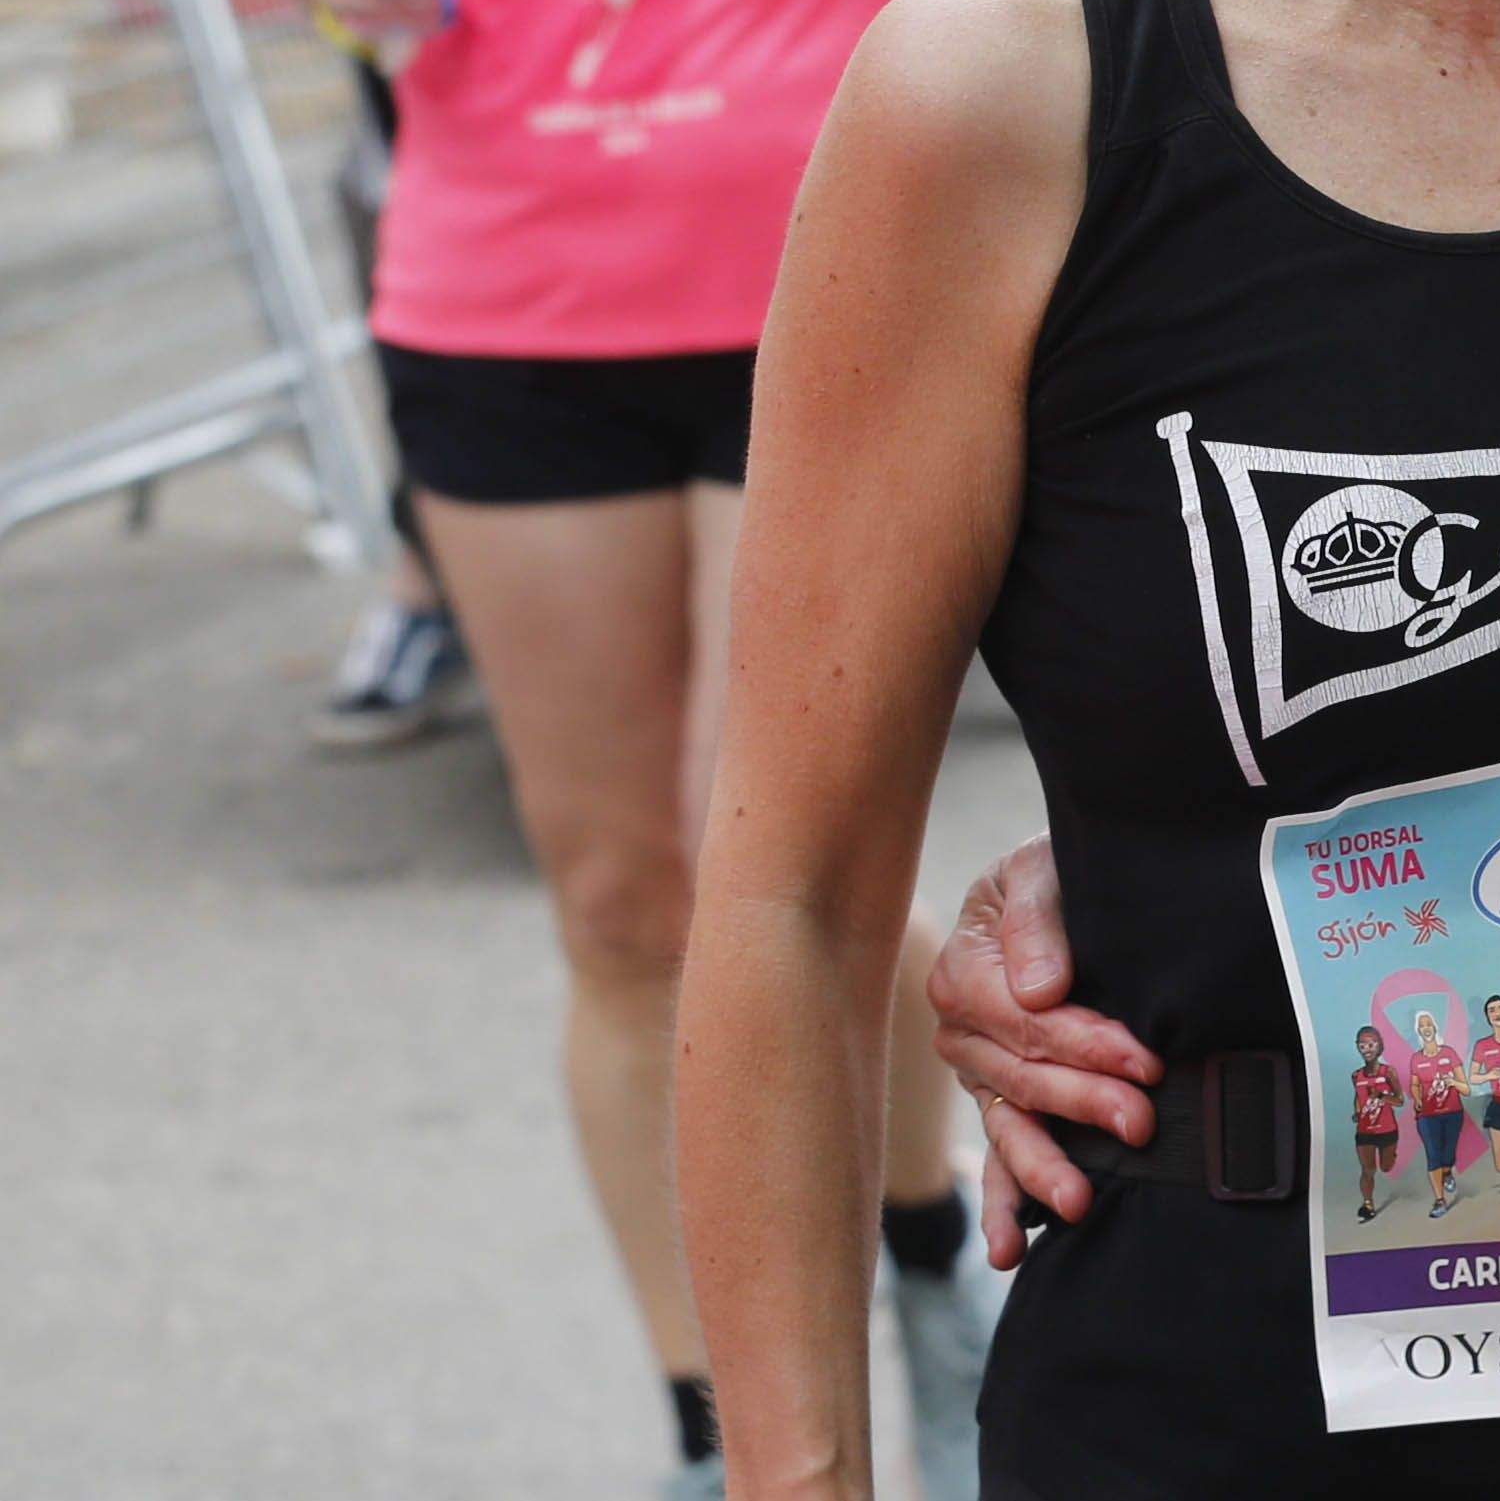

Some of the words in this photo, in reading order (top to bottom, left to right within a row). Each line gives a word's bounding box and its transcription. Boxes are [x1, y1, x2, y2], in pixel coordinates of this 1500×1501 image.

[1304, 840, 1332, 861] TU
[1340, 824, 1424, 856] DORSAL
[1311, 848, 1425, 900] SUMA
[1317, 911, 1398, 959] gijón
